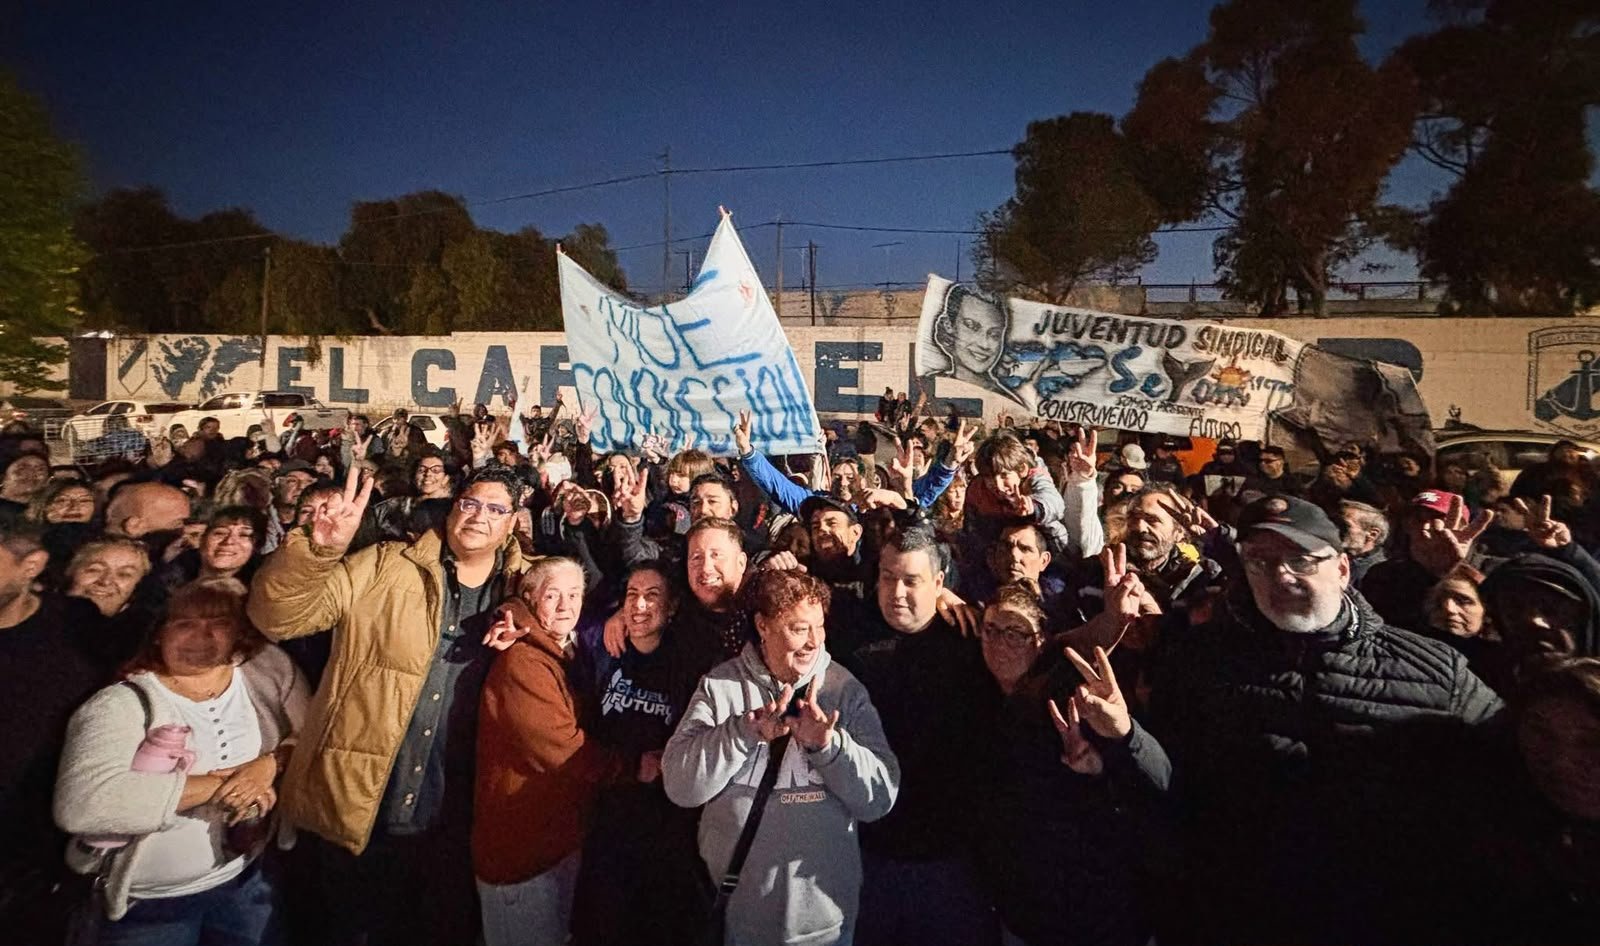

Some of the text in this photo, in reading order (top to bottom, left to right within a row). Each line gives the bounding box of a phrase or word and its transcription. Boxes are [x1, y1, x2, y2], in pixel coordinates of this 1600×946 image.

[1033, 310, 1188, 349] JUVENTUD
[1192, 325, 1288, 363] SINDICAL
[277, 346, 369, 404] EL
[1037, 399, 1149, 431] CONSTRUYENDO
[1189, 414, 1242, 441] FUTURO
[781, 791, 826, 803] OFF THE WALL
